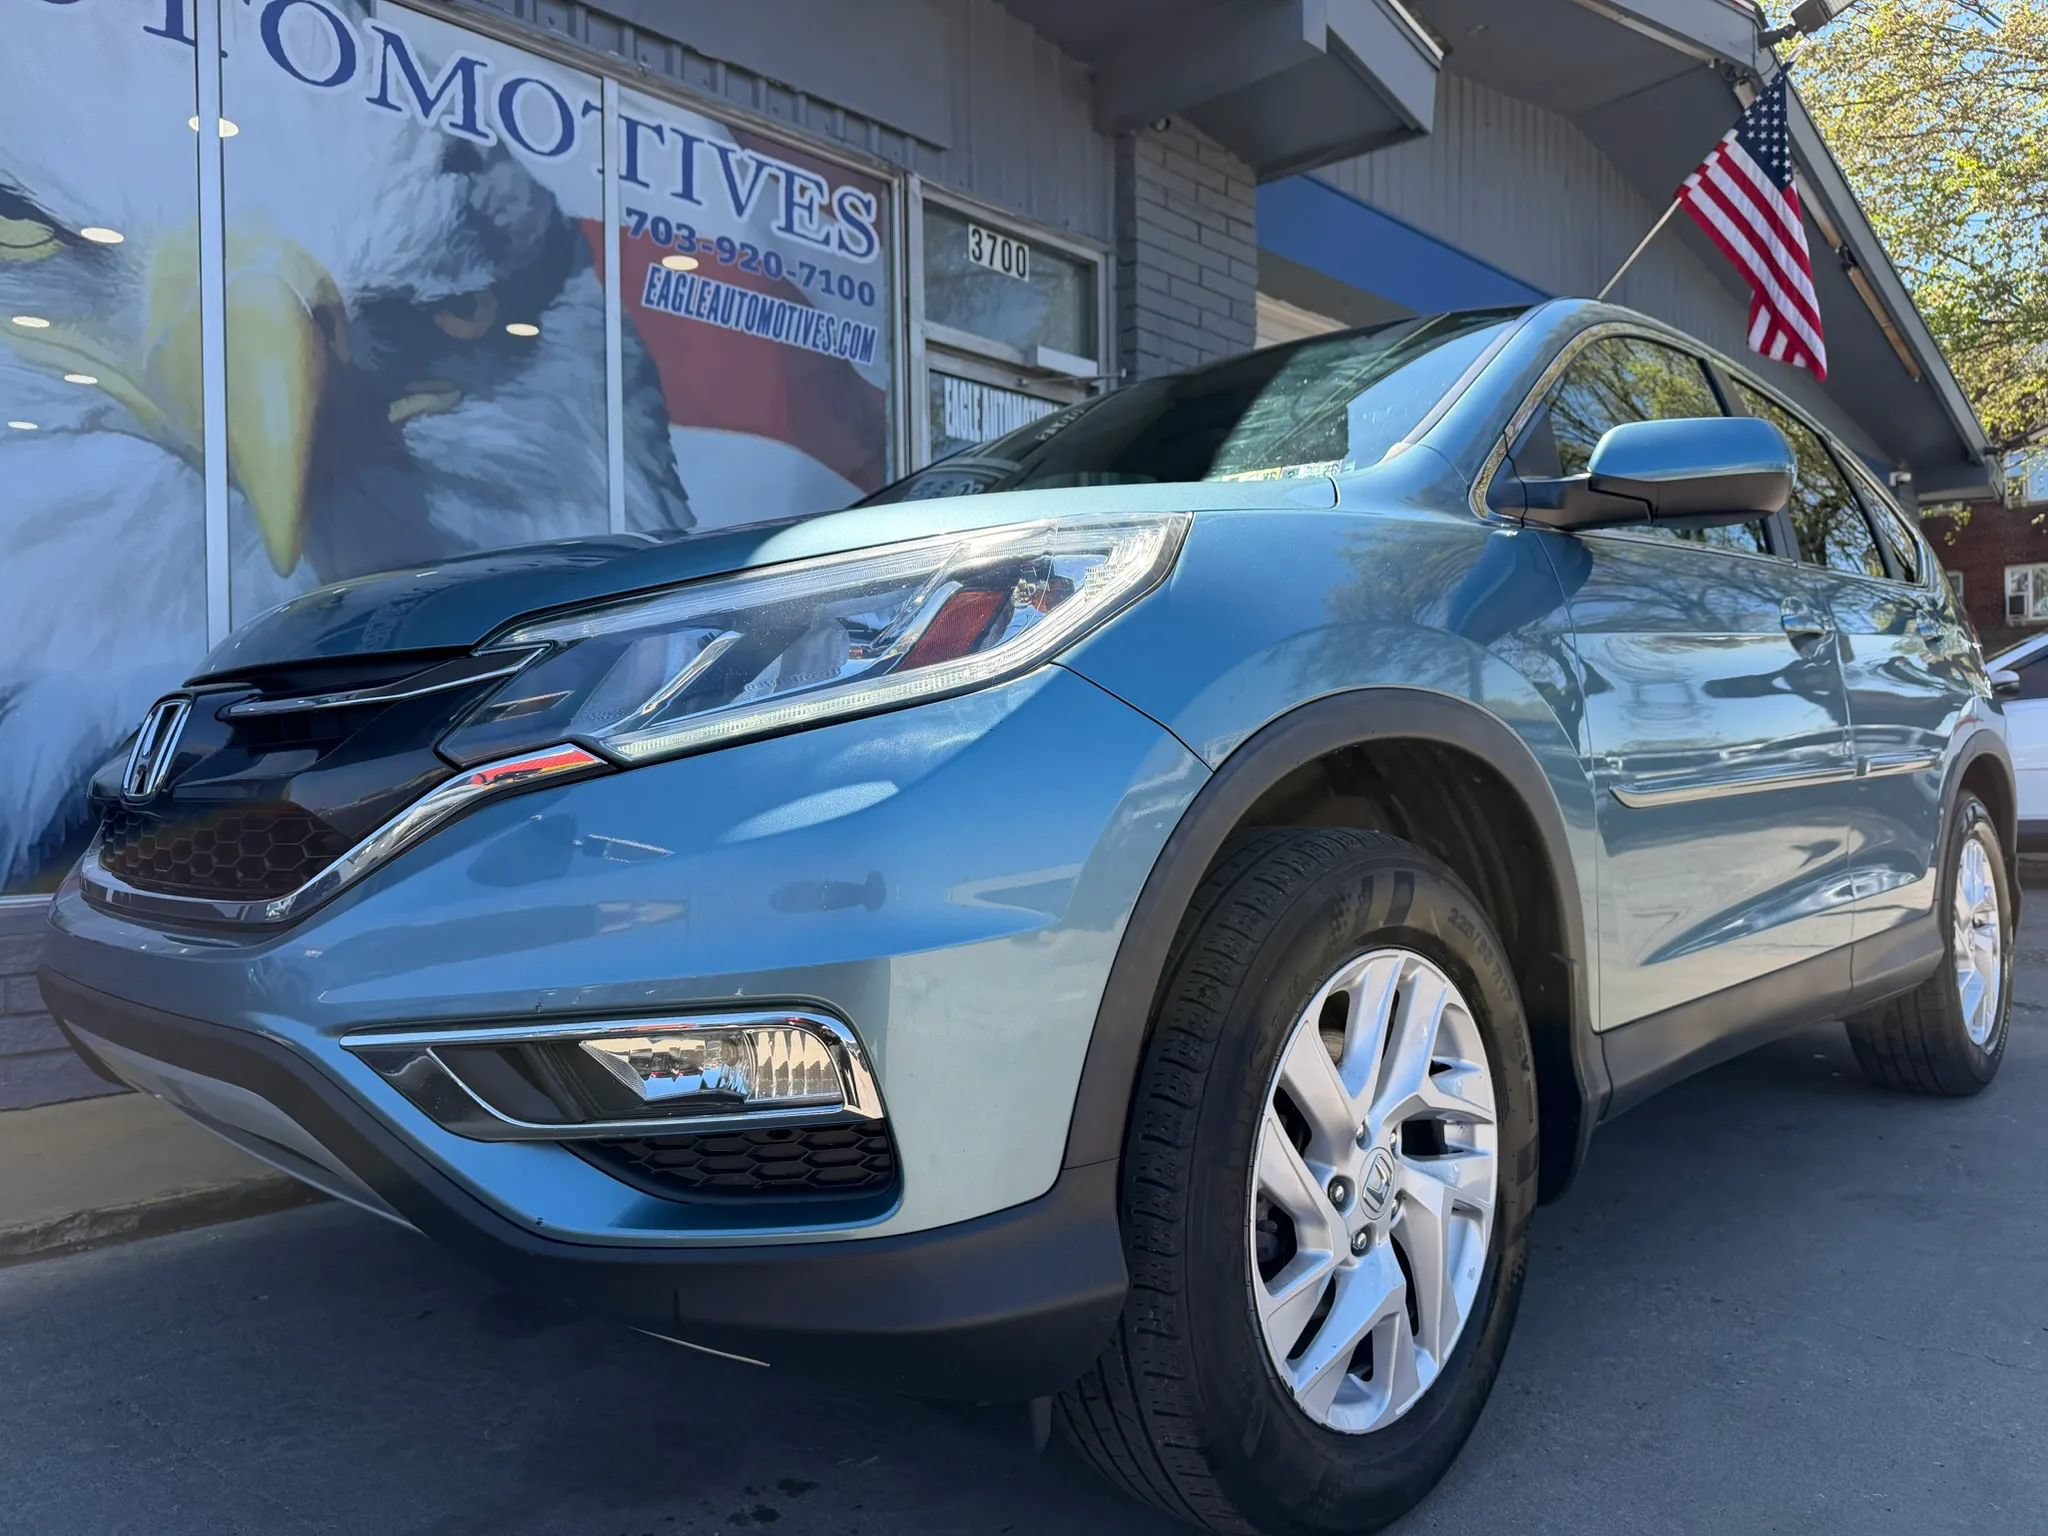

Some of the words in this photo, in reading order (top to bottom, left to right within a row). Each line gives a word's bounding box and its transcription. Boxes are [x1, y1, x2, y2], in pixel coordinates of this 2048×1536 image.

[625, 207, 875, 307] 703-920-7100
[971, 228, 1027, 279] 3700
[643, 265, 876, 364] EAGLEAUTOMOTIVES.COM
